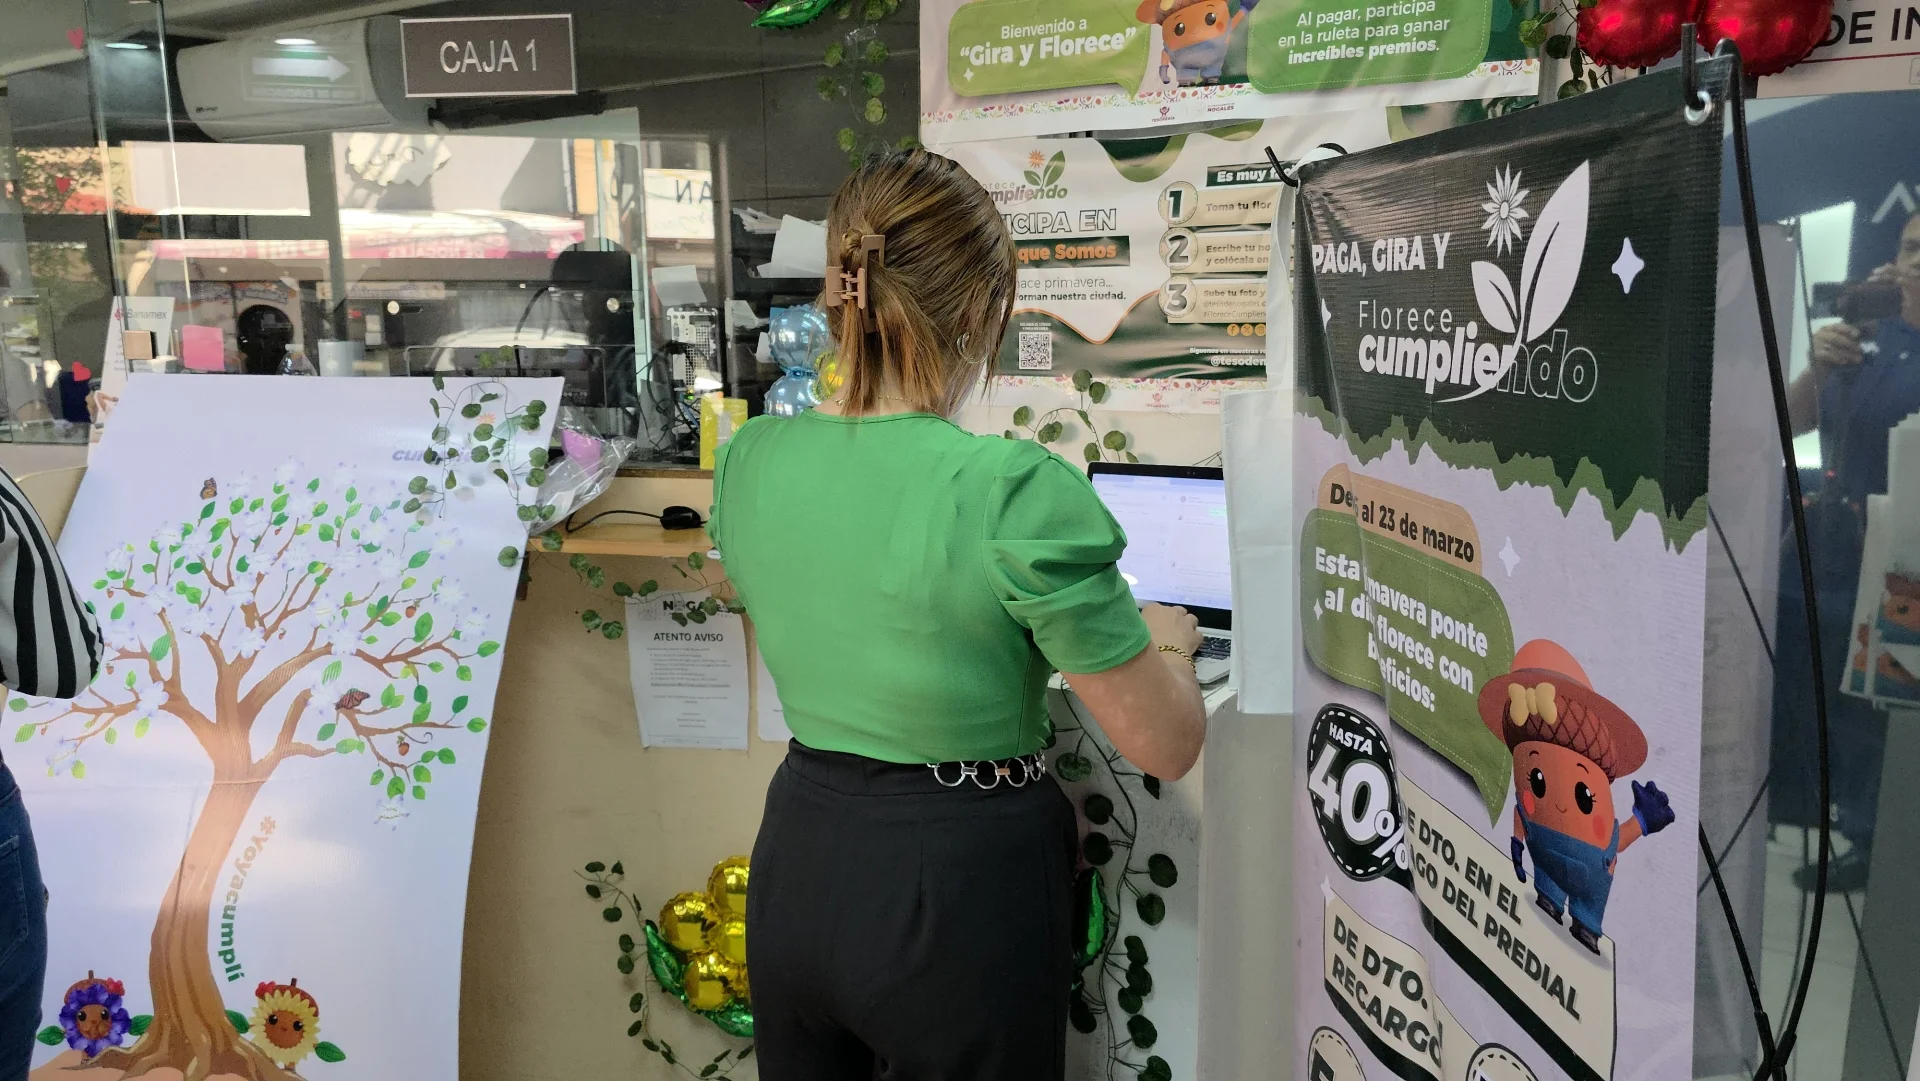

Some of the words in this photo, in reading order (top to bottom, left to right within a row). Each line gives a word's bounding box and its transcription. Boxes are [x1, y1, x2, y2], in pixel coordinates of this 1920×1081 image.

[1296, 12, 1312, 27] Al
[1316, 8, 1361, 28] pagar,
[1366, 0, 1436, 21] participa
[1001, 18, 1075, 40] Bienvenido
[1079, 18, 1087, 30] a
[1278, 35, 1296, 47] en
[1301, 31, 1313, 45] la
[1317, 26, 1360, 43] ruleta
[1364, 24, 1399, 41] para
[1403, 19, 1451, 37] ganar
[440, 40, 519, 73] CAJA
[526, 39, 537, 71] 1
[1019, 43, 1034, 67] y
[1288, 44, 1365, 65] increíbles
[1368, 37, 1440, 60] premios.
[982, 181, 1016, 191] orece
[1216, 170, 1234, 183] Es
[1236, 169, 1267, 182] muy
[990, 184, 1068, 206] mpliendo
[1167, 189, 1183, 219] 1
[1206, 202, 1235, 212] Toma
[1237, 201, 1249, 210] tu
[1252, 200, 1272, 210] flor
[1079, 208, 1118, 233] EN
[1017, 246, 1051, 265] que
[1054, 243, 1118, 260] Somos
[1167, 234, 1190, 264] 2
[1205, 257, 1212, 267] y
[1214, 255, 1255, 265] colócala
[1206, 243, 1245, 253] Escribe
[1247, 244, 1255, 252] tu
[1312, 242, 1367, 277] PAGA,
[1372, 235, 1426, 272] GIRA
[1432, 232, 1451, 270] Y
[1050, 291, 1087, 301] nuestra
[1090, 291, 1127, 301] ciudad.
[1166, 283, 1188, 312] 3
[1203, 289, 1226, 297] Sube
[1228, 289, 1237, 297] tu
[1239, 288, 1258, 297] foto
[1259, 290, 1266, 299] y
[1358, 300, 1453, 334] Florece
[1210, 356, 1267, 367] @tesoden
[1358, 320, 1599, 403] cumpliendo
[1361, 500, 1375, 525] al
[1379, 505, 1396, 532] 23
[1400, 512, 1418, 541] de
[1423, 525, 1475, 563] marzo
[1315, 546, 1361, 582] Esta
[1431, 608, 1489, 658] ponte
[653, 632, 692, 642] ATENTO
[694, 633, 724, 642] AVISO
[1324, 587, 1345, 613] al
[1377, 614, 1434, 670] florece
[1439, 655, 1474, 695] con
[1329, 722, 1373, 756] HASTA
[1307, 741, 1410, 871] 40%
[1418, 818, 1460, 873] DTO.
[1464, 856, 1493, 899] EN
[1496, 882, 1522, 926] EL
[1333, 914, 1359, 960] DE
[1362, 943, 1428, 1011] DTO.
[1442, 876, 1479, 929] DEL
[1483, 912, 1580, 1022] PREDIAL
[1331, 952, 1443, 1069] RECARGO
